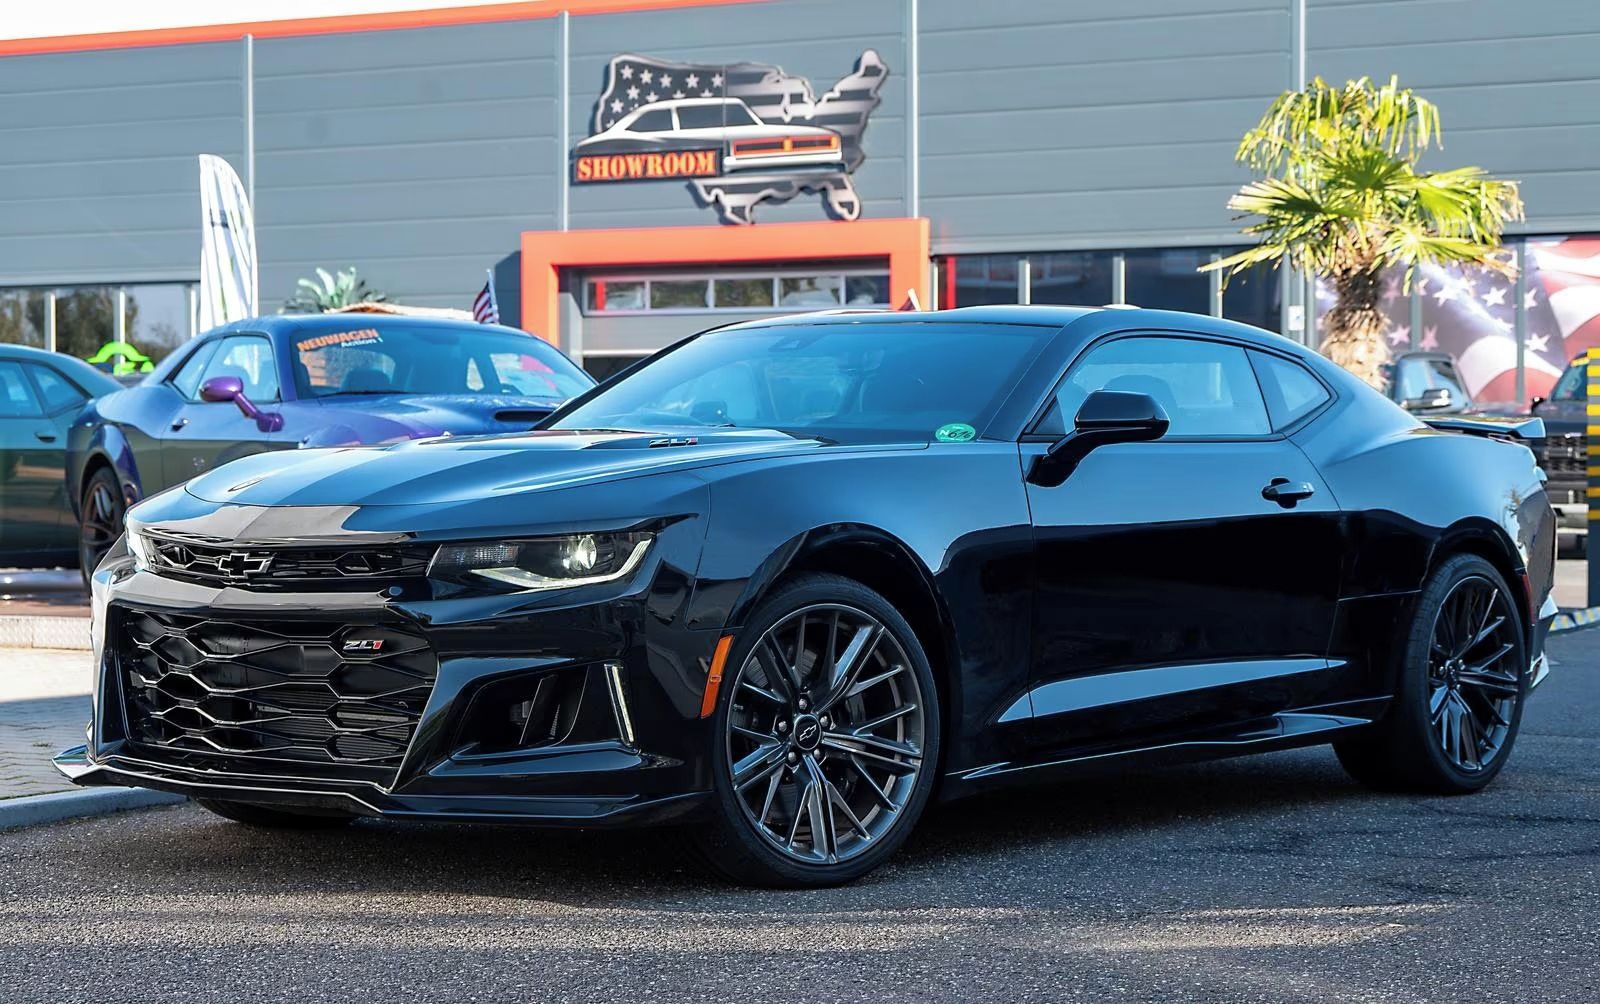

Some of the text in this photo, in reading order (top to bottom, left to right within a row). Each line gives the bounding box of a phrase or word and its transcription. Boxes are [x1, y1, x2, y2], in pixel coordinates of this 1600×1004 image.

[577, 151, 716, 182] SHOWROOM
[296, 328, 379, 352] NEUWAGEN
[342, 639, 384, 650] ZL1
